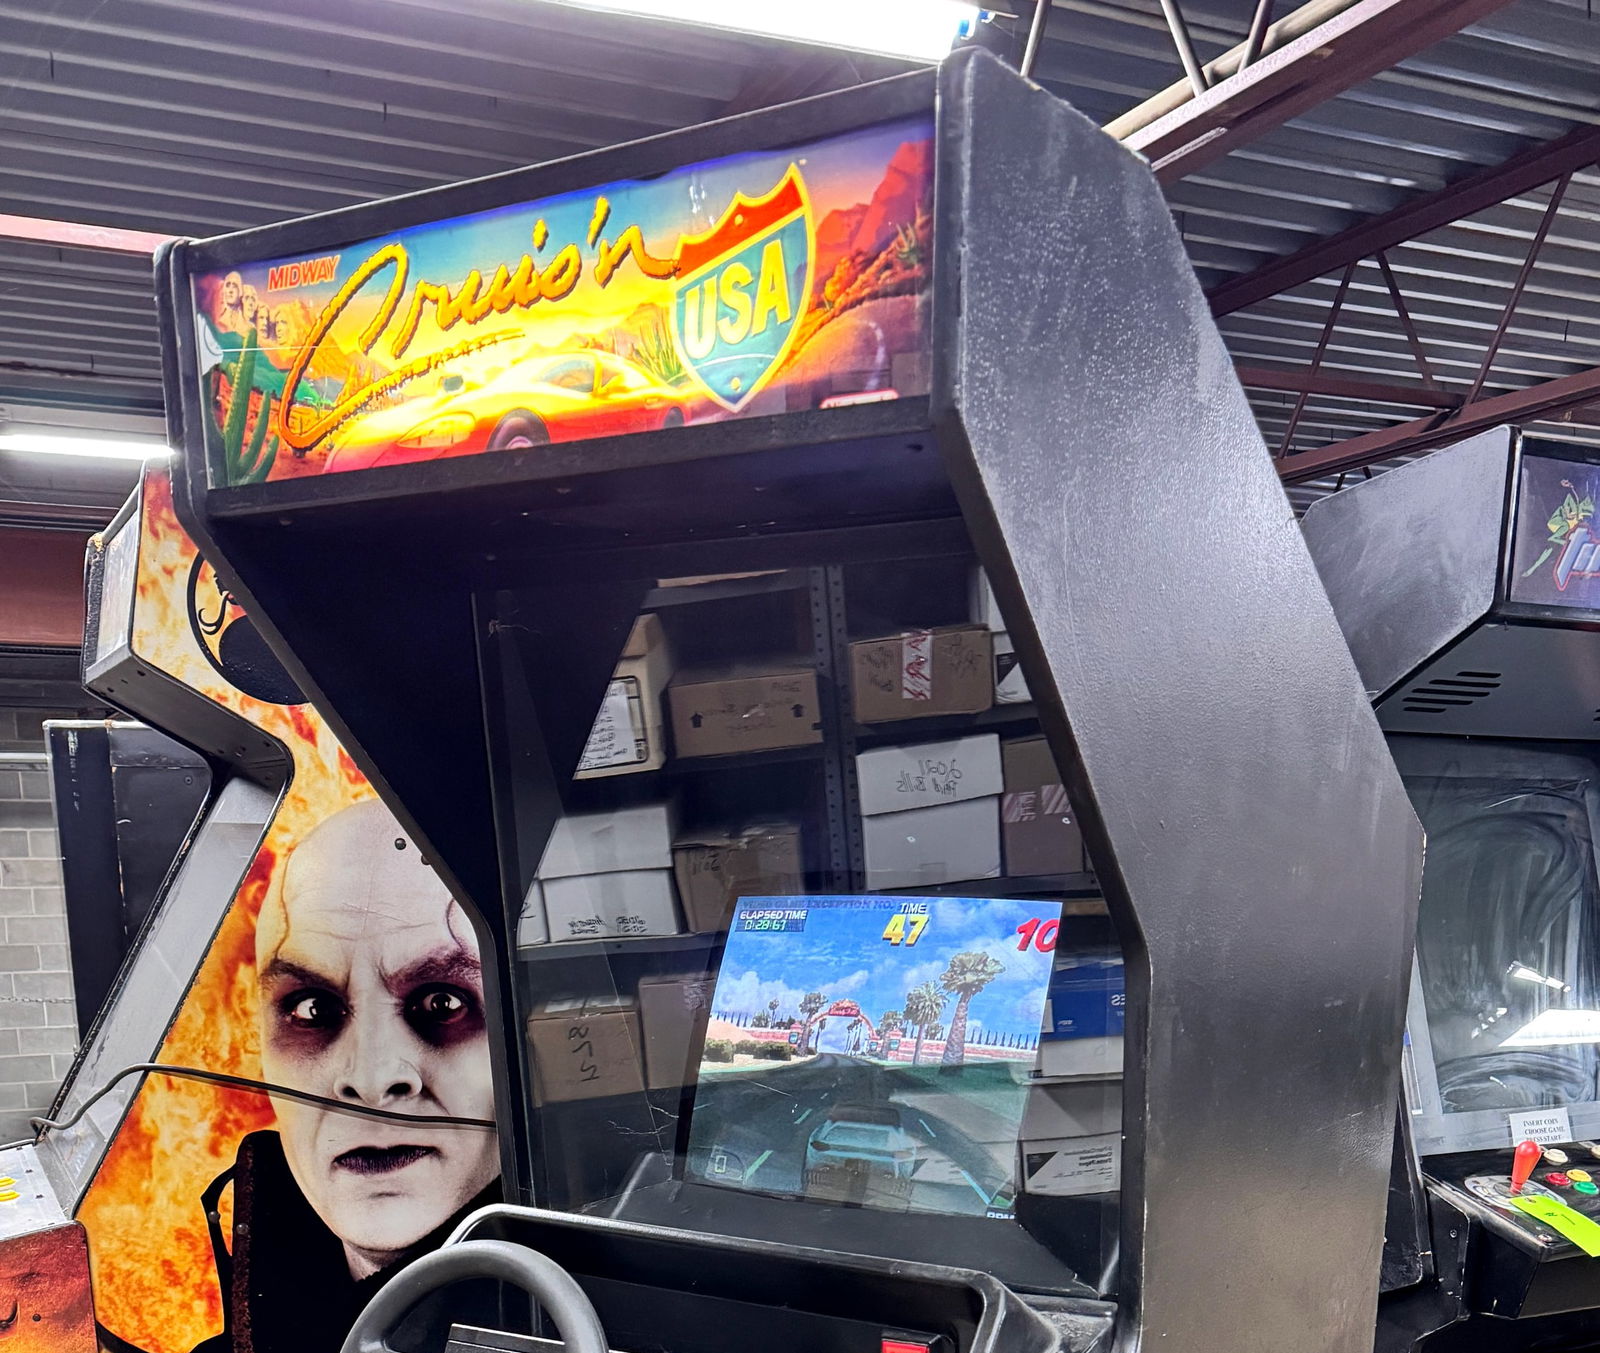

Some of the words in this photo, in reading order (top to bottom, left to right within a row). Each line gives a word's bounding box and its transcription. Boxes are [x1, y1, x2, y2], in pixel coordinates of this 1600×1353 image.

[268, 254, 341, 292] MIDWAY
[683, 238, 793, 360] USA
[739, 909, 783, 921] ELAPSED
[784, 909, 807, 920] TIME
[900, 902, 927, 915] TIME
[882, 913, 930, 947] 47
[1543, 1117, 1559, 1126] COIN
[1524, 1128, 1547, 1136] CHOOSE
